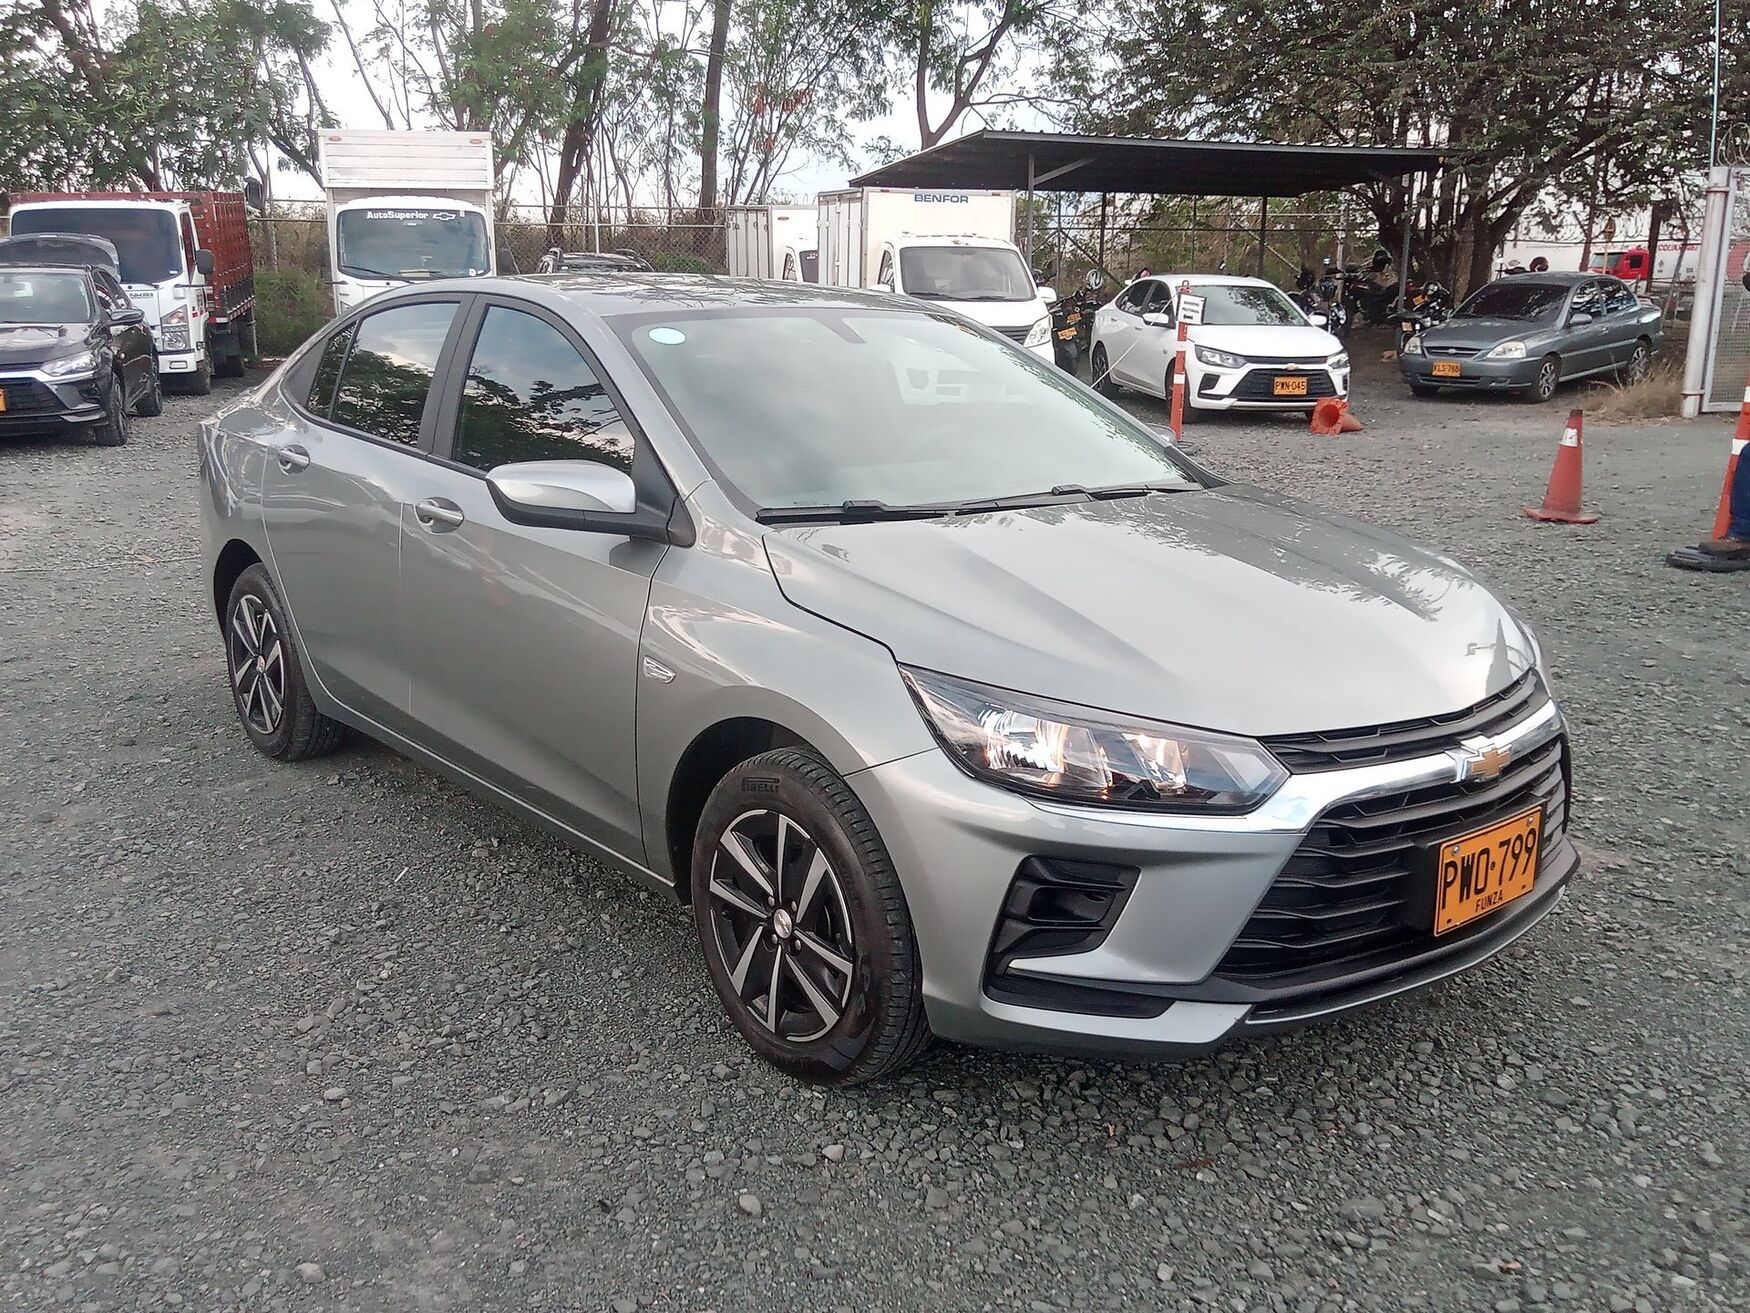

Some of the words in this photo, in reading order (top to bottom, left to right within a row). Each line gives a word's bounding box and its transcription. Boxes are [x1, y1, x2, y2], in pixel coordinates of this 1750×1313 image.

[914, 194, 969, 204] BENFOR
[366, 211, 429, 220] AutoSuperior
[1475, 890, 1504, 912] FUNZA
